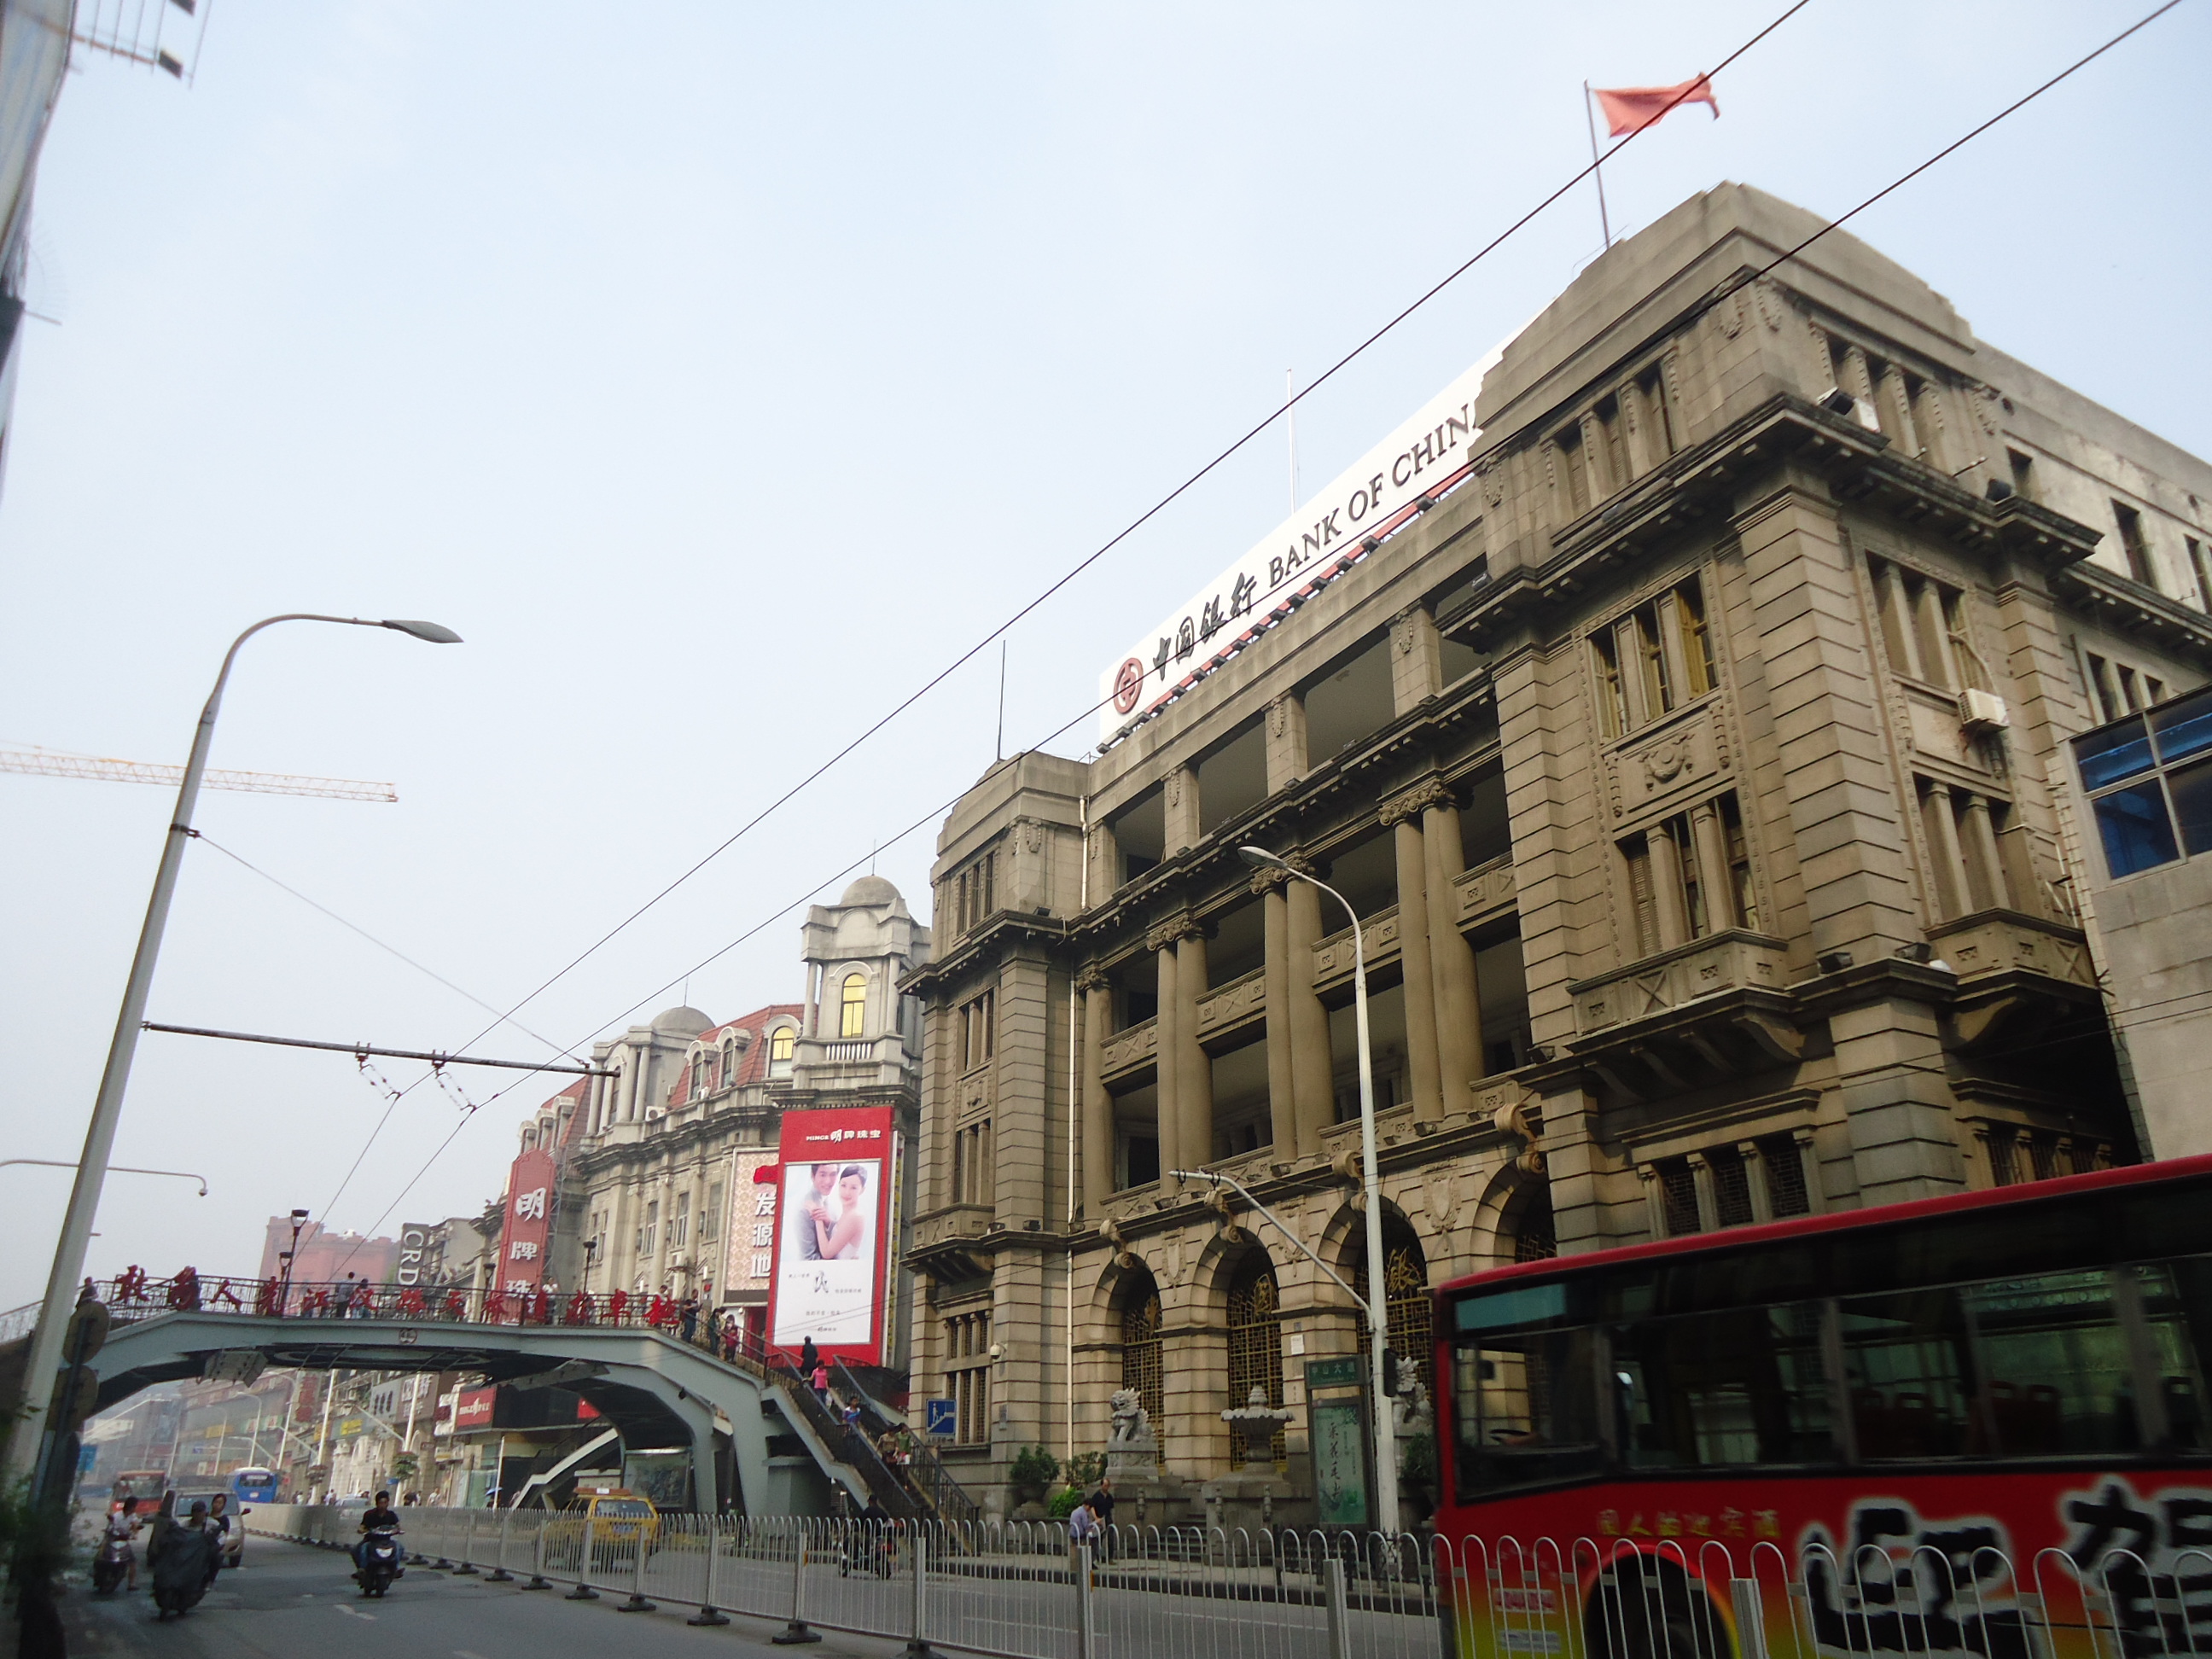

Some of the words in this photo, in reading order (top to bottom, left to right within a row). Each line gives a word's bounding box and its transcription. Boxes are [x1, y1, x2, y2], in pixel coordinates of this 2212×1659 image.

[1268, 507, 1342, 590] BANK
[1347, 472, 1384, 522] OF
[1390, 403, 1476, 488] CHIN
[830, 1128, 881, 1144] 明牌珠宝
[398, 1229, 425, 1286] CRD
[750, 1192, 777, 1278] 发源地
